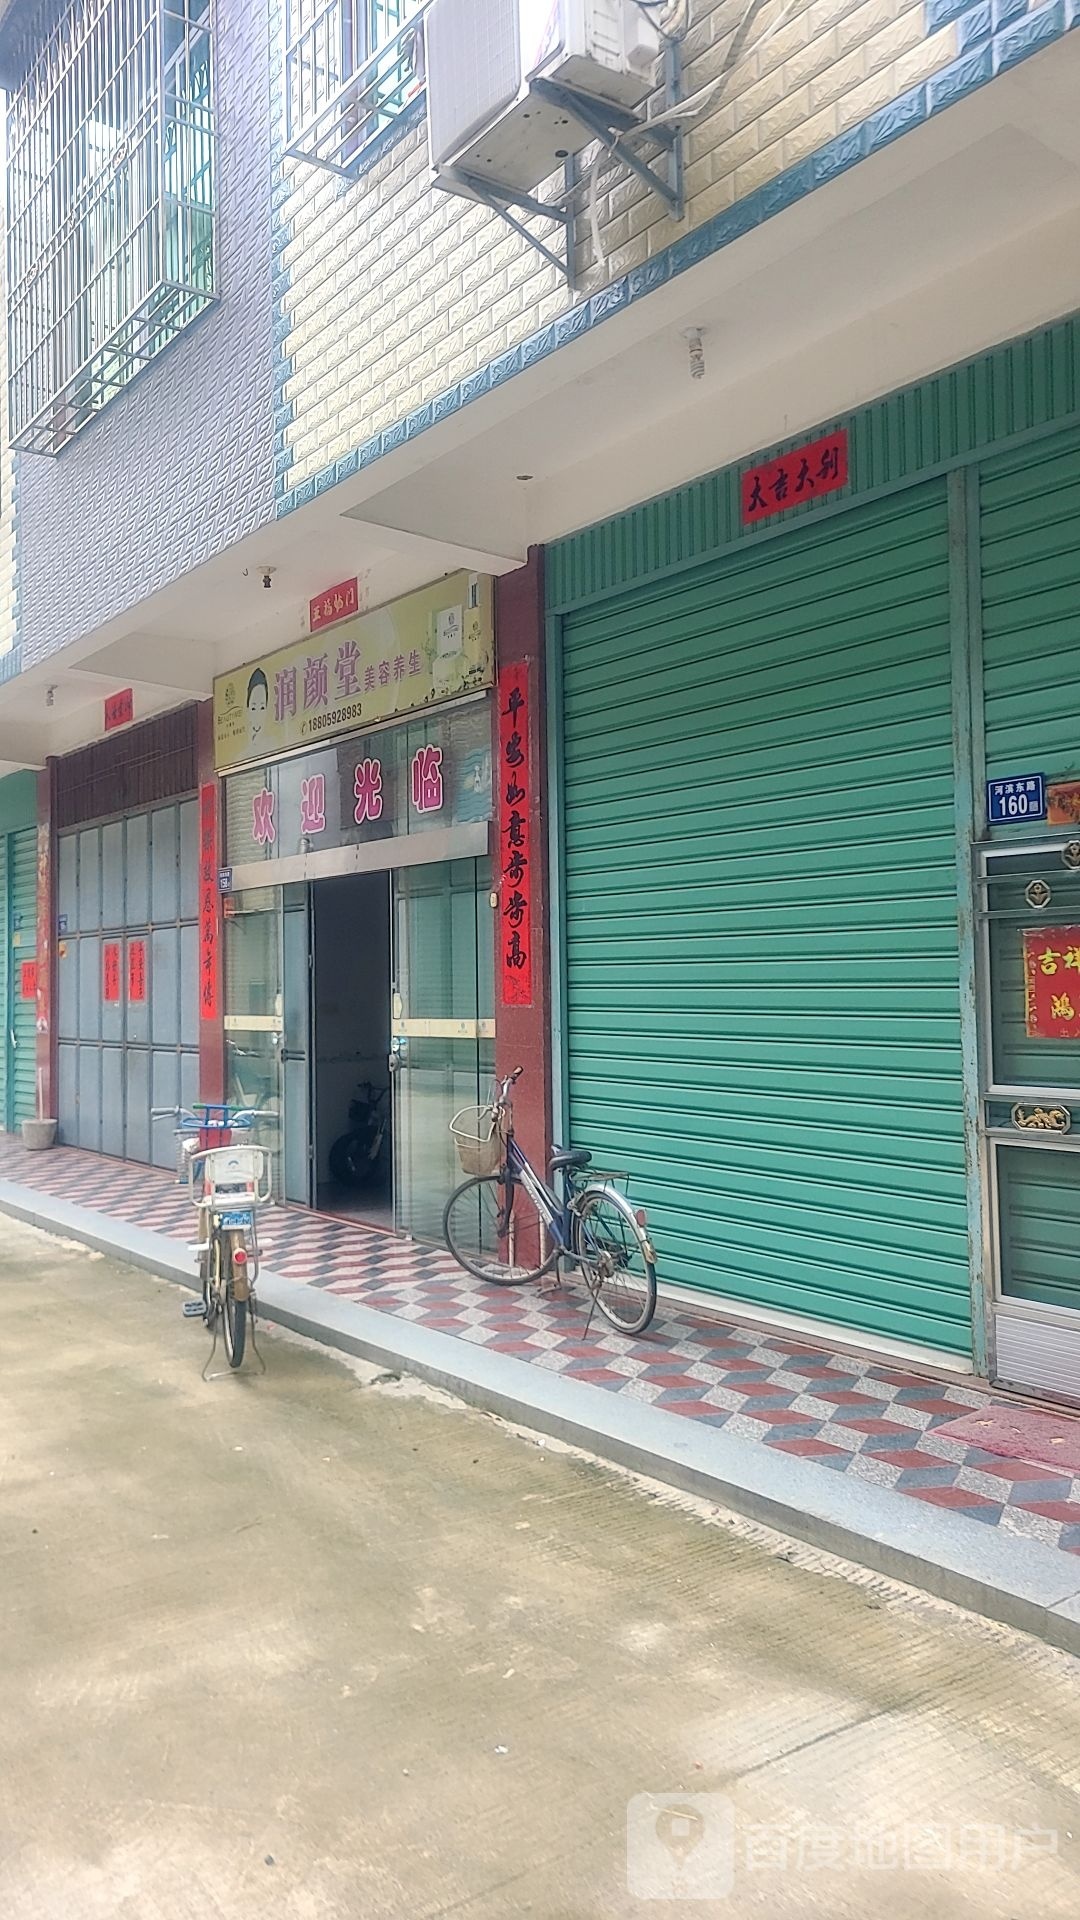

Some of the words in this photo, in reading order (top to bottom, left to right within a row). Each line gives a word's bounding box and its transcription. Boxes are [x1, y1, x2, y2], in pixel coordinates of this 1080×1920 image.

[748, 447, 839, 512] 大吉大利
[274, 640, 361, 722] 润颜堂
[364, 650, 422, 695] 美容养生
[308, 703, 362, 732] 18805928983
[252, 744, 443, 845] 欢迎光临
[994, 780, 1036, 796] 河滨东路
[999, 793, 1028, 816] 160
[501, 687, 528, 970] 平安如意步步高
